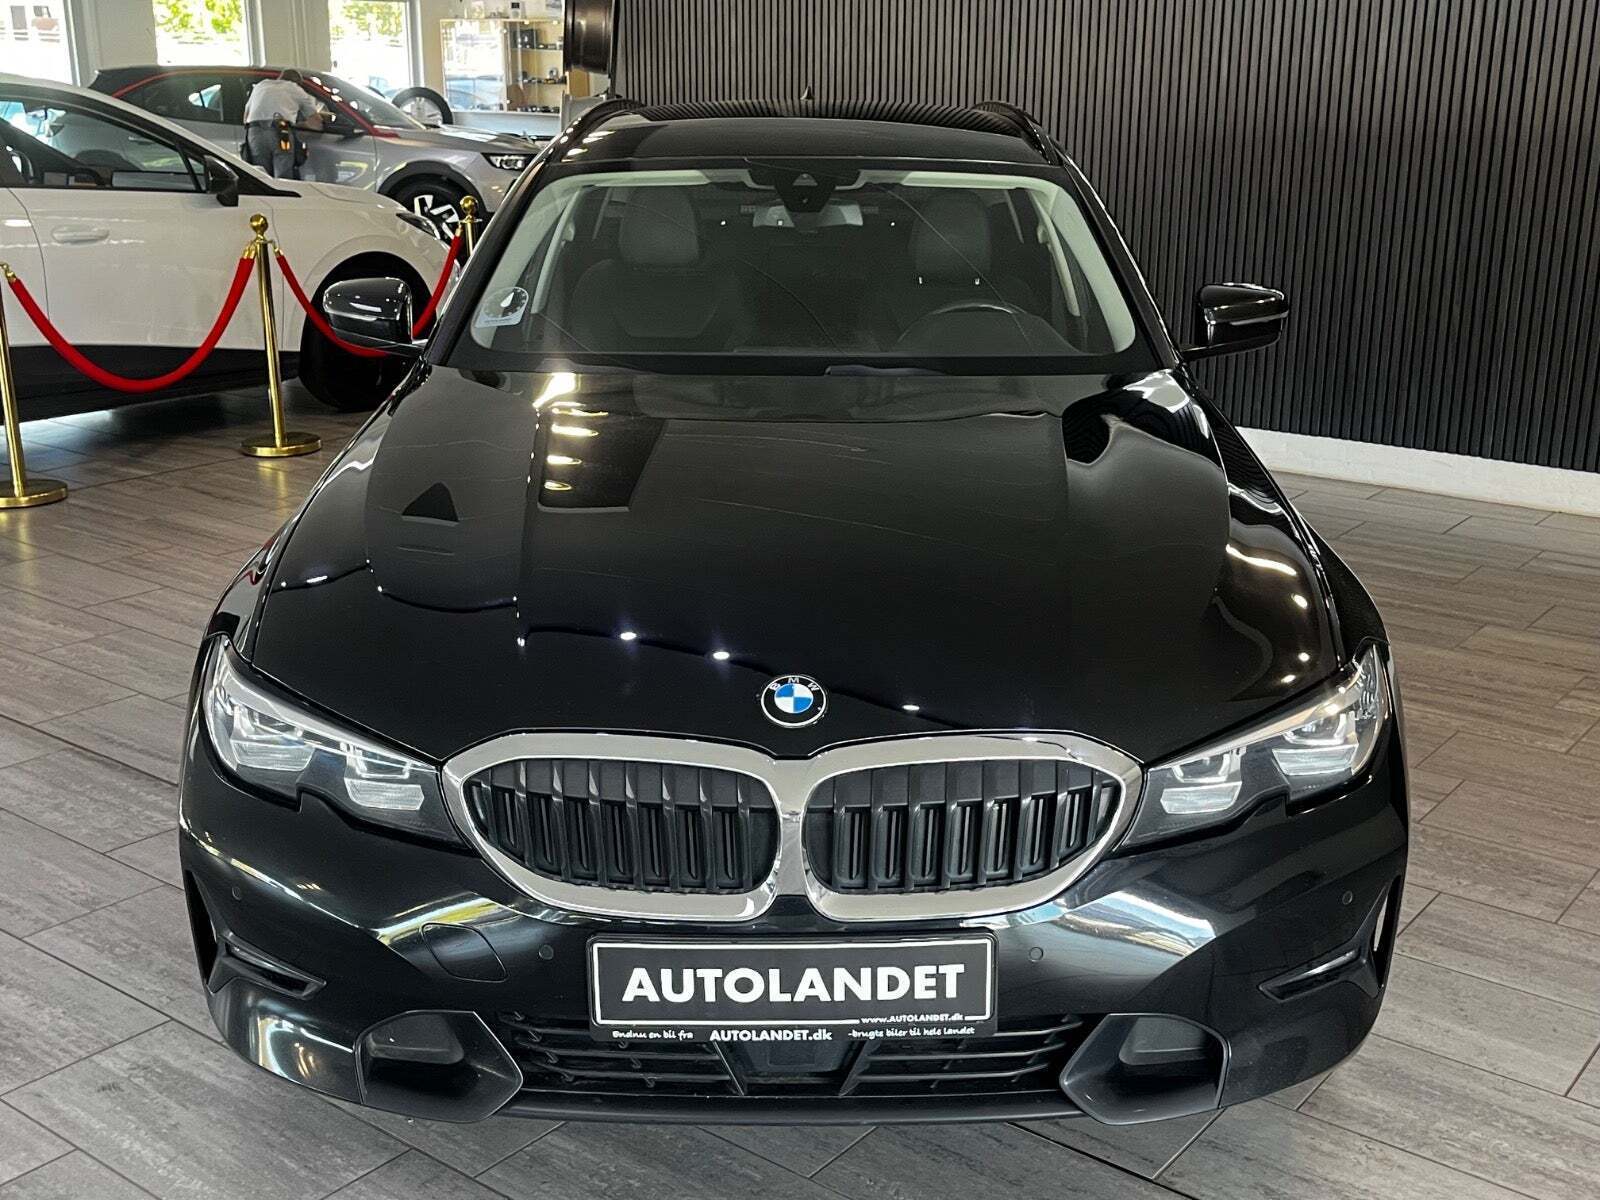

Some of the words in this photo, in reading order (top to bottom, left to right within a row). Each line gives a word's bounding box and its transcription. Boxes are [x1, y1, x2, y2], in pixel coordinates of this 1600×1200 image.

[769, 677, 820, 691] BMW
[622, 964, 965, 1003] AUTOLANDET
[861, 1013, 963, 1023] www.AUTOLANDET.dk
[663, 1030, 676, 1039] bil
[678, 1030, 693, 1040] fra
[710, 1029, 832, 1041] AUTOLANDET.dk
[886, 1028, 907, 1037] biler
[909, 1028, 921, 1036] til
[923, 1027, 942, 1036] hele
[944, 1026, 975, 1035] landet
